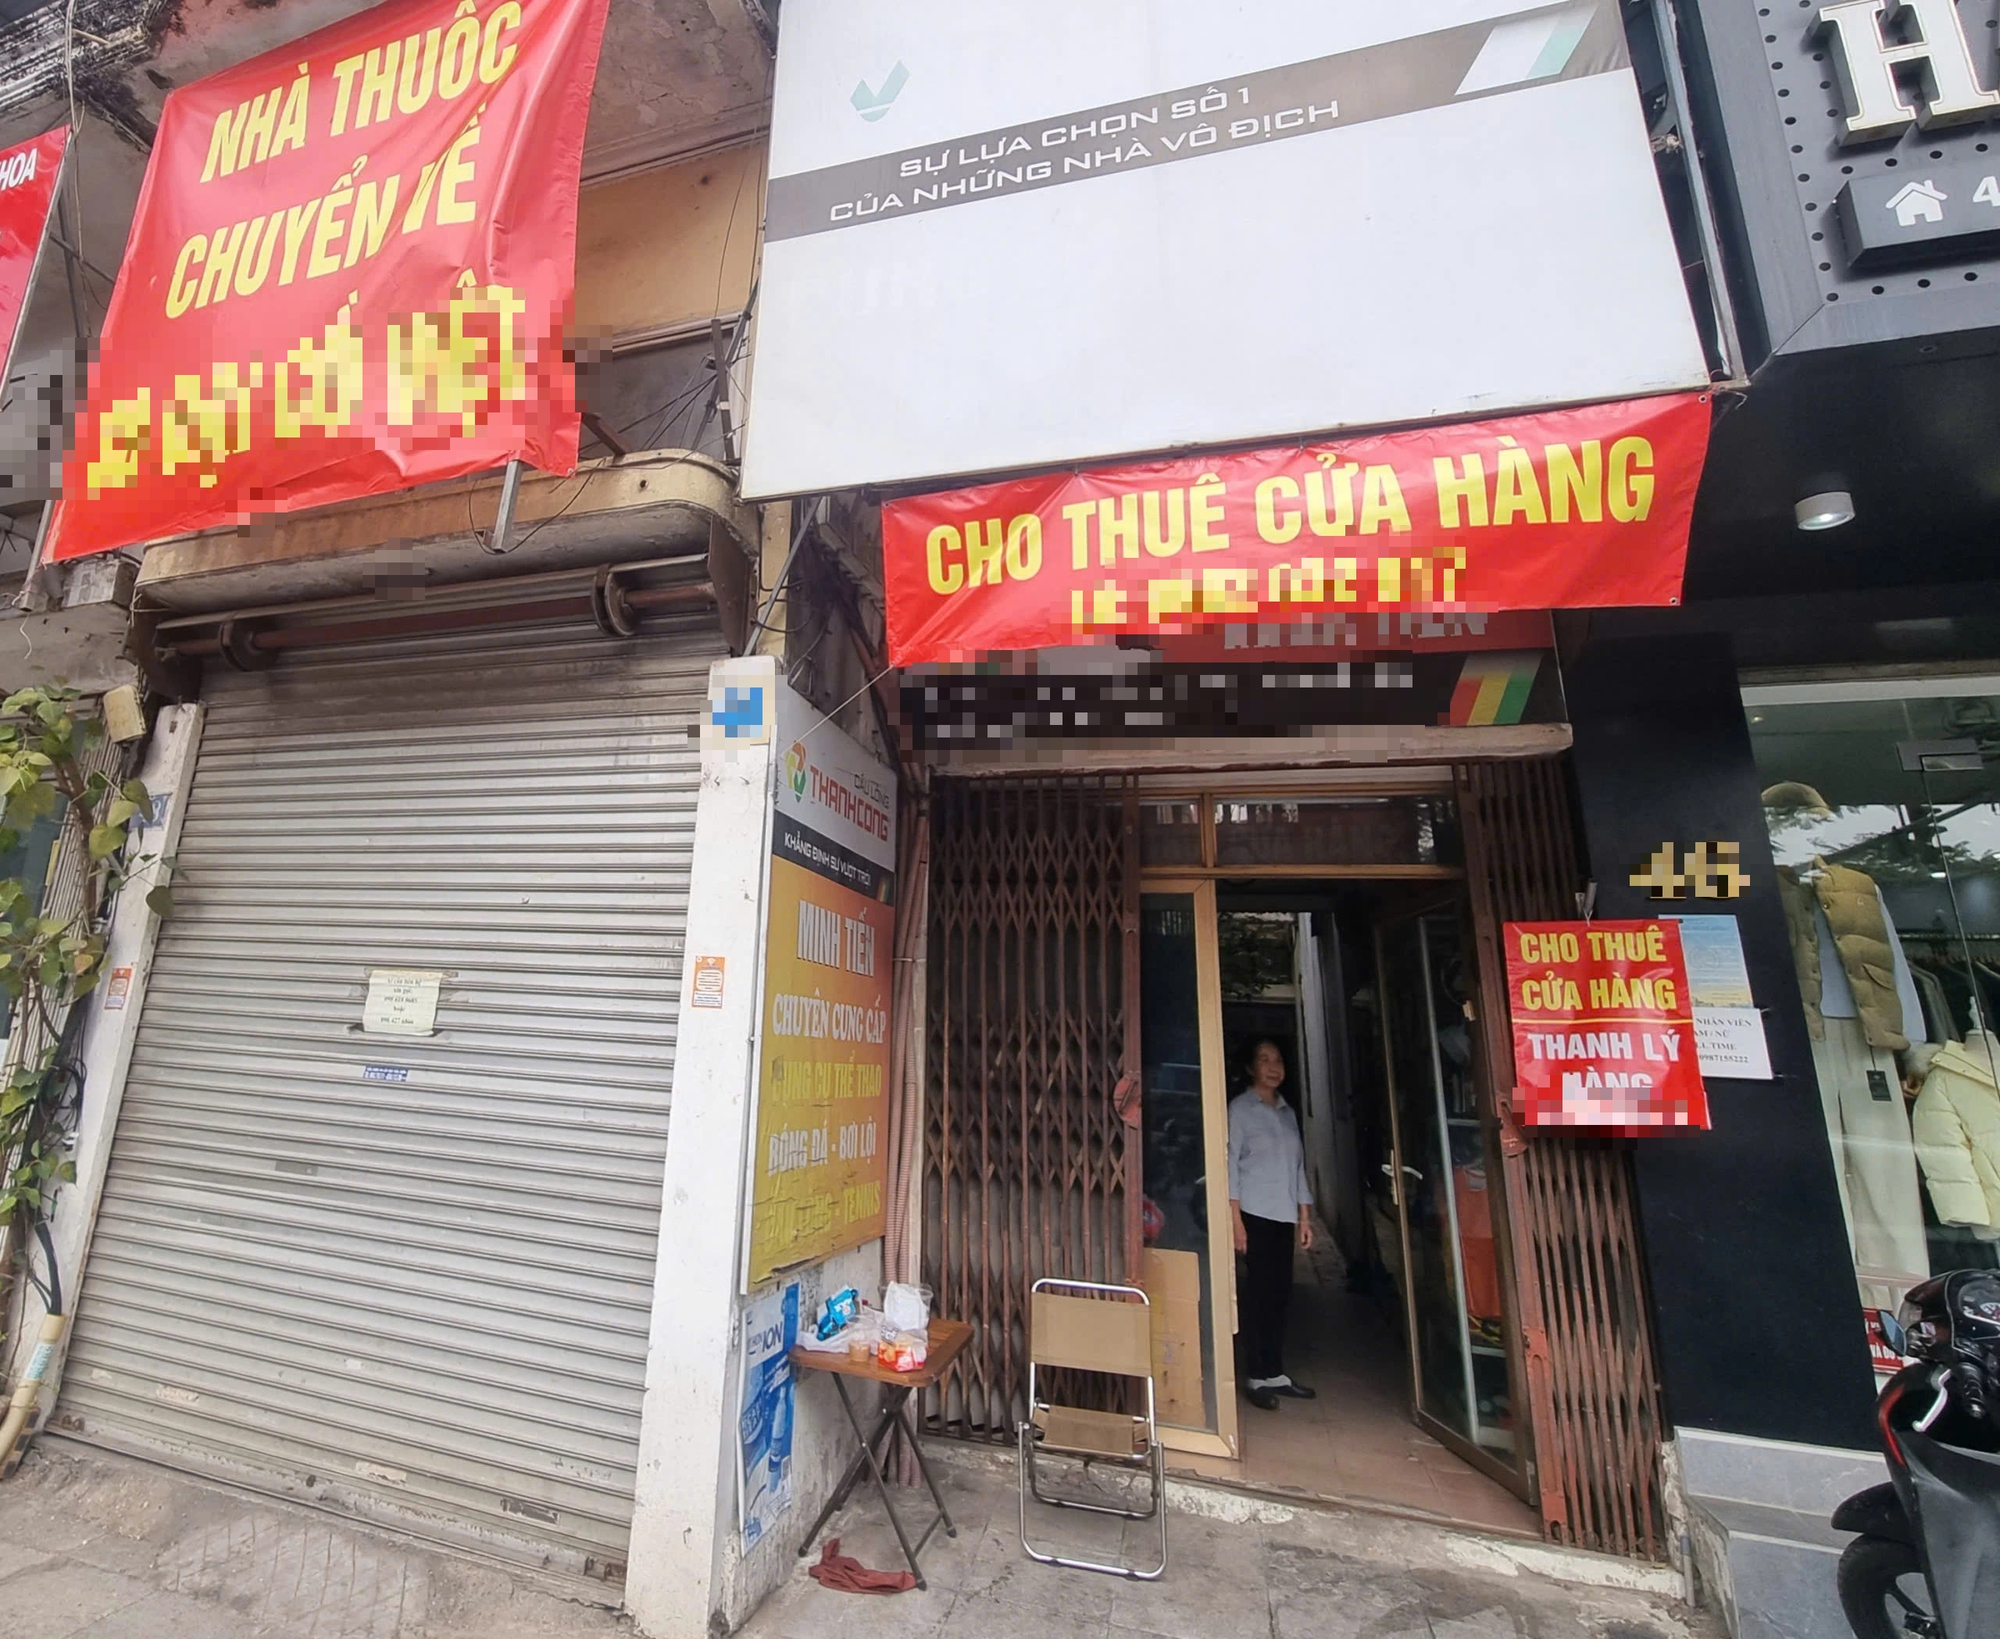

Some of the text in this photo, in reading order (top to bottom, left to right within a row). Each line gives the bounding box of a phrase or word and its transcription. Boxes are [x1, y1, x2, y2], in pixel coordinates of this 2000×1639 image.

[200, 62, 310, 183] NHÀ
[900, 86, 1250, 178] SỰ LỰA CHỌN SỐ 1
[830, 100, 1340, 221] CỦA NHỮNG NHÀ VÔ ĐỊCH
[165, 155, 401, 319] CHUYỂN
[925, 512, 1042, 595] CHO
[1063, 471, 1230, 571] THUÊ
[1254, 453, 1410, 538] CỬA
[1434, 436, 1656, 530] HÀNG
[797, 899, 875, 977] MINH TIẾN
[1520, 932, 1579, 963] CHO
[1588, 925, 1667, 963] THUÊ
[772, 989, 887, 1044] CHUYÊN CUNG CẤP
[1522, 970, 1677, 1012] CỬA HÀNG
[833, 1050, 855, 1099] THỂ
[856, 1063, 882, 1098] THAO
[1527, 1029, 1680, 1062] THANH LÝ
[768, 1122, 808, 1177] BÓNG
[811, 1119, 828, 1167] ĐÁ
